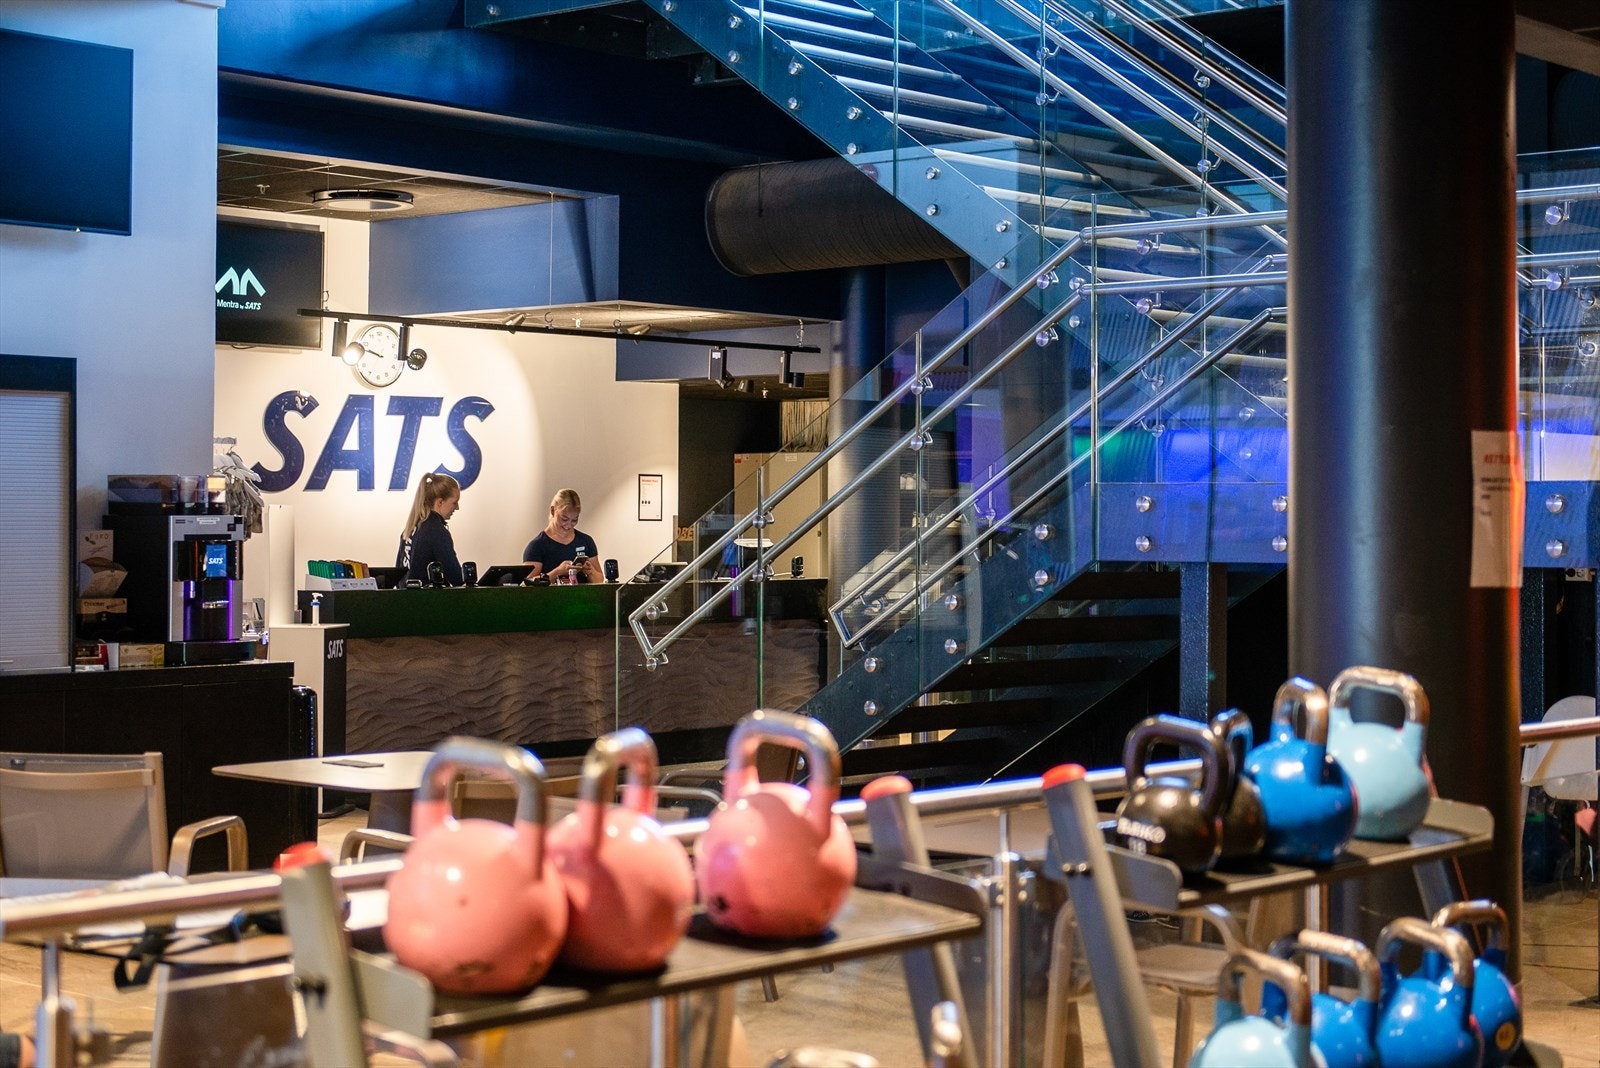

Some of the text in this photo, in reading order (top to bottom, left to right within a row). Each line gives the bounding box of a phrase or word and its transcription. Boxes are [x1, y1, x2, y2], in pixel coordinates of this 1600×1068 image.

[216, 299, 240, 309] Mentra
[244, 301, 262, 311] SATS
[250, 390, 496, 493] SATS
[208, 557, 223, 565] SATS
[327, 639, 344, 659] SATS
